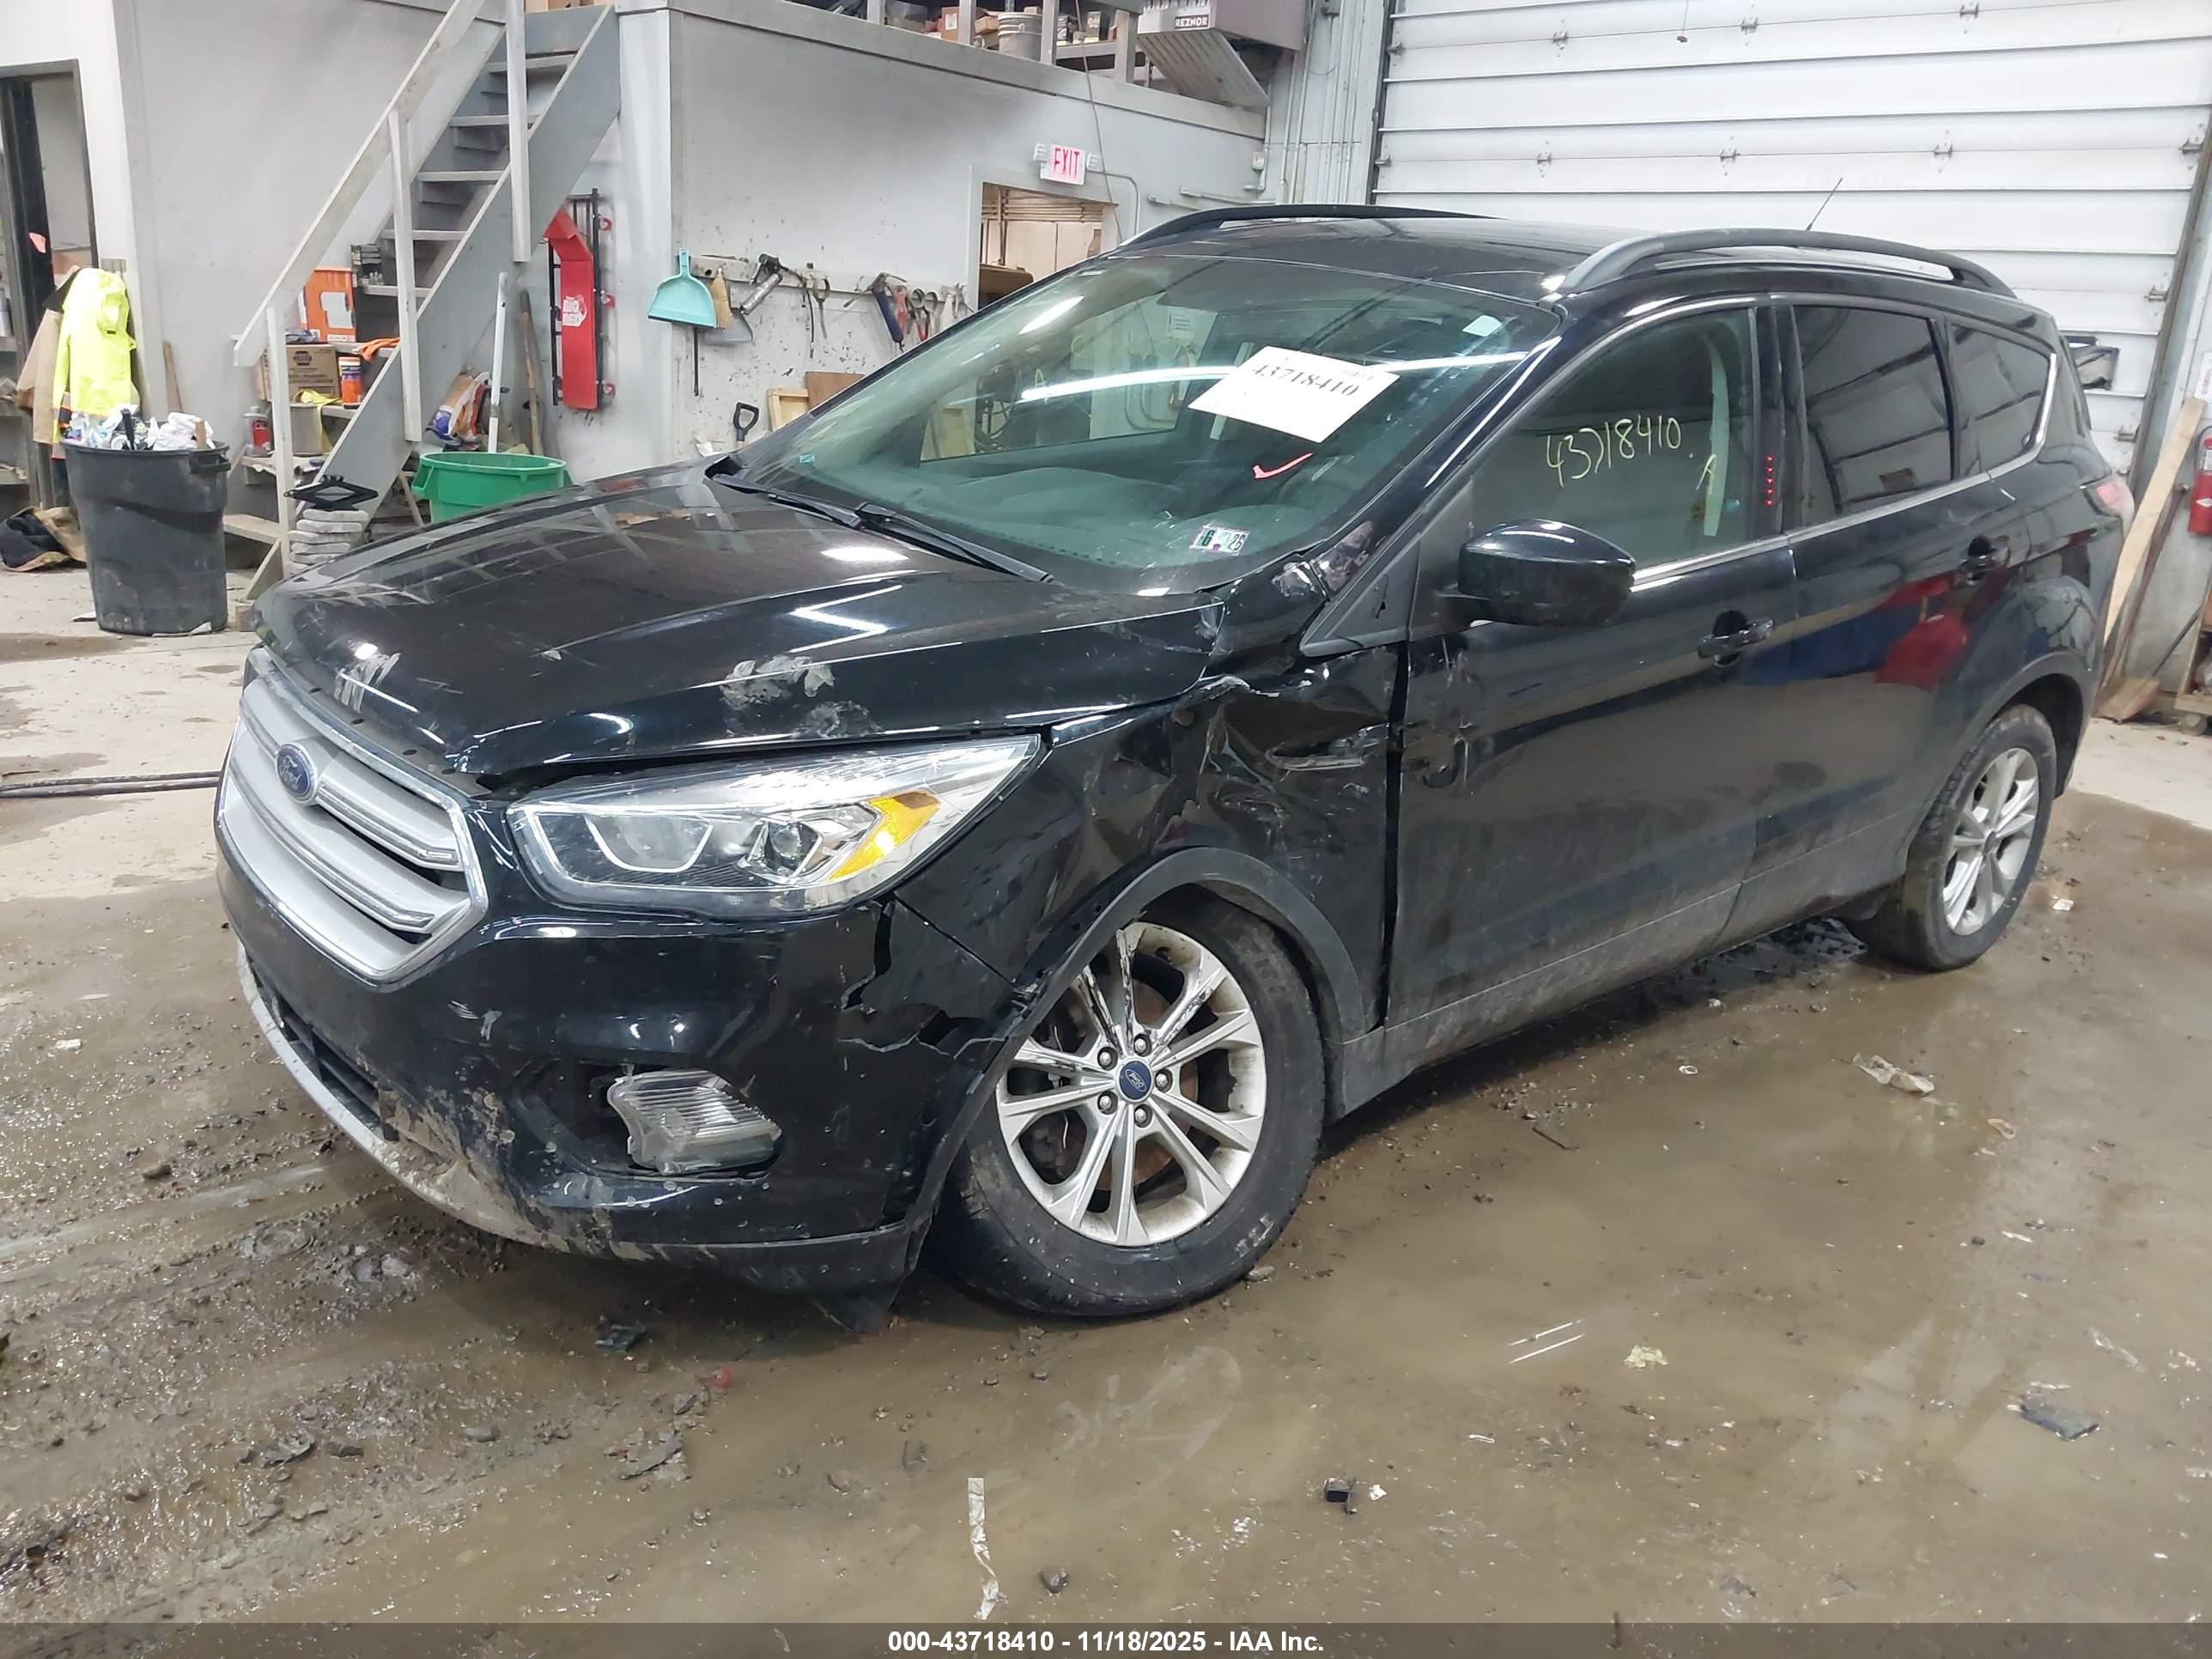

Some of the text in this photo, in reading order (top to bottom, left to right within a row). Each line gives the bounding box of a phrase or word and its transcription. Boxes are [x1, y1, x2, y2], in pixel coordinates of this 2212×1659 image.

[1175, 17, 1208, 27] REZNOR
[1053, 147, 1080, 179] EXIT
[1252, 364, 1360, 397] 43718410
